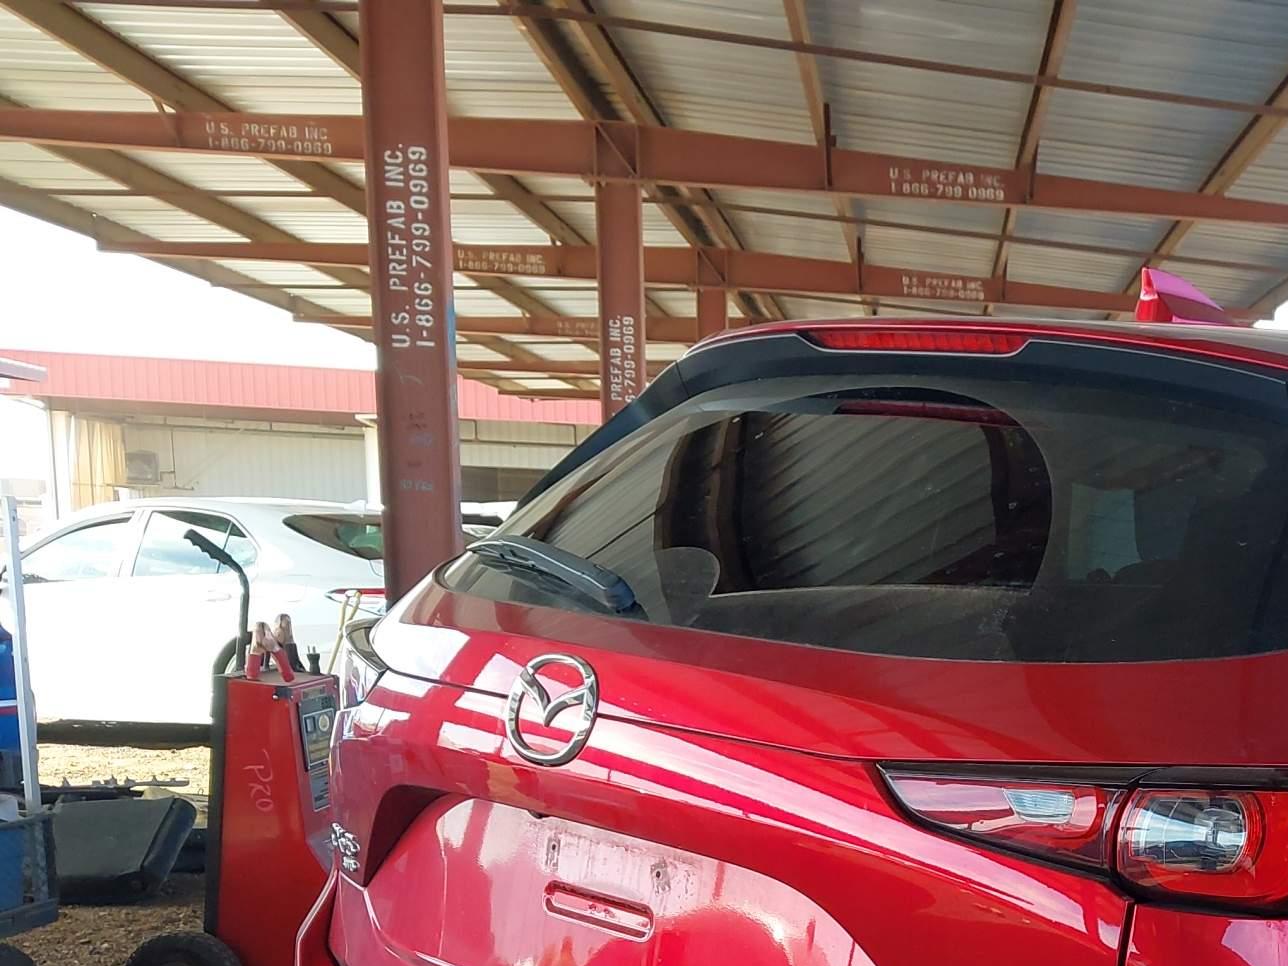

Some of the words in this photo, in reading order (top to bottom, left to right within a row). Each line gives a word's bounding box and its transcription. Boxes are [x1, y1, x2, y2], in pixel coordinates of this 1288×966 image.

[205, 121, 233, 135] US.
[241, 123, 297, 138] PREFAB
[384, 143, 404, 187] INC.
[922, 169, 973, 185] PREFAB
[890, 182, 1004, 200] 1866-7990969
[386, 200, 409, 290] PREFAB
[408, 146, 435, 347] 1-866-799-0969
[391, 304, 411, 348] U.S.
[609, 315, 621, 341] INC.
[610, 348, 622, 400] PREFAB
[242, 748, 274, 811] PRO
